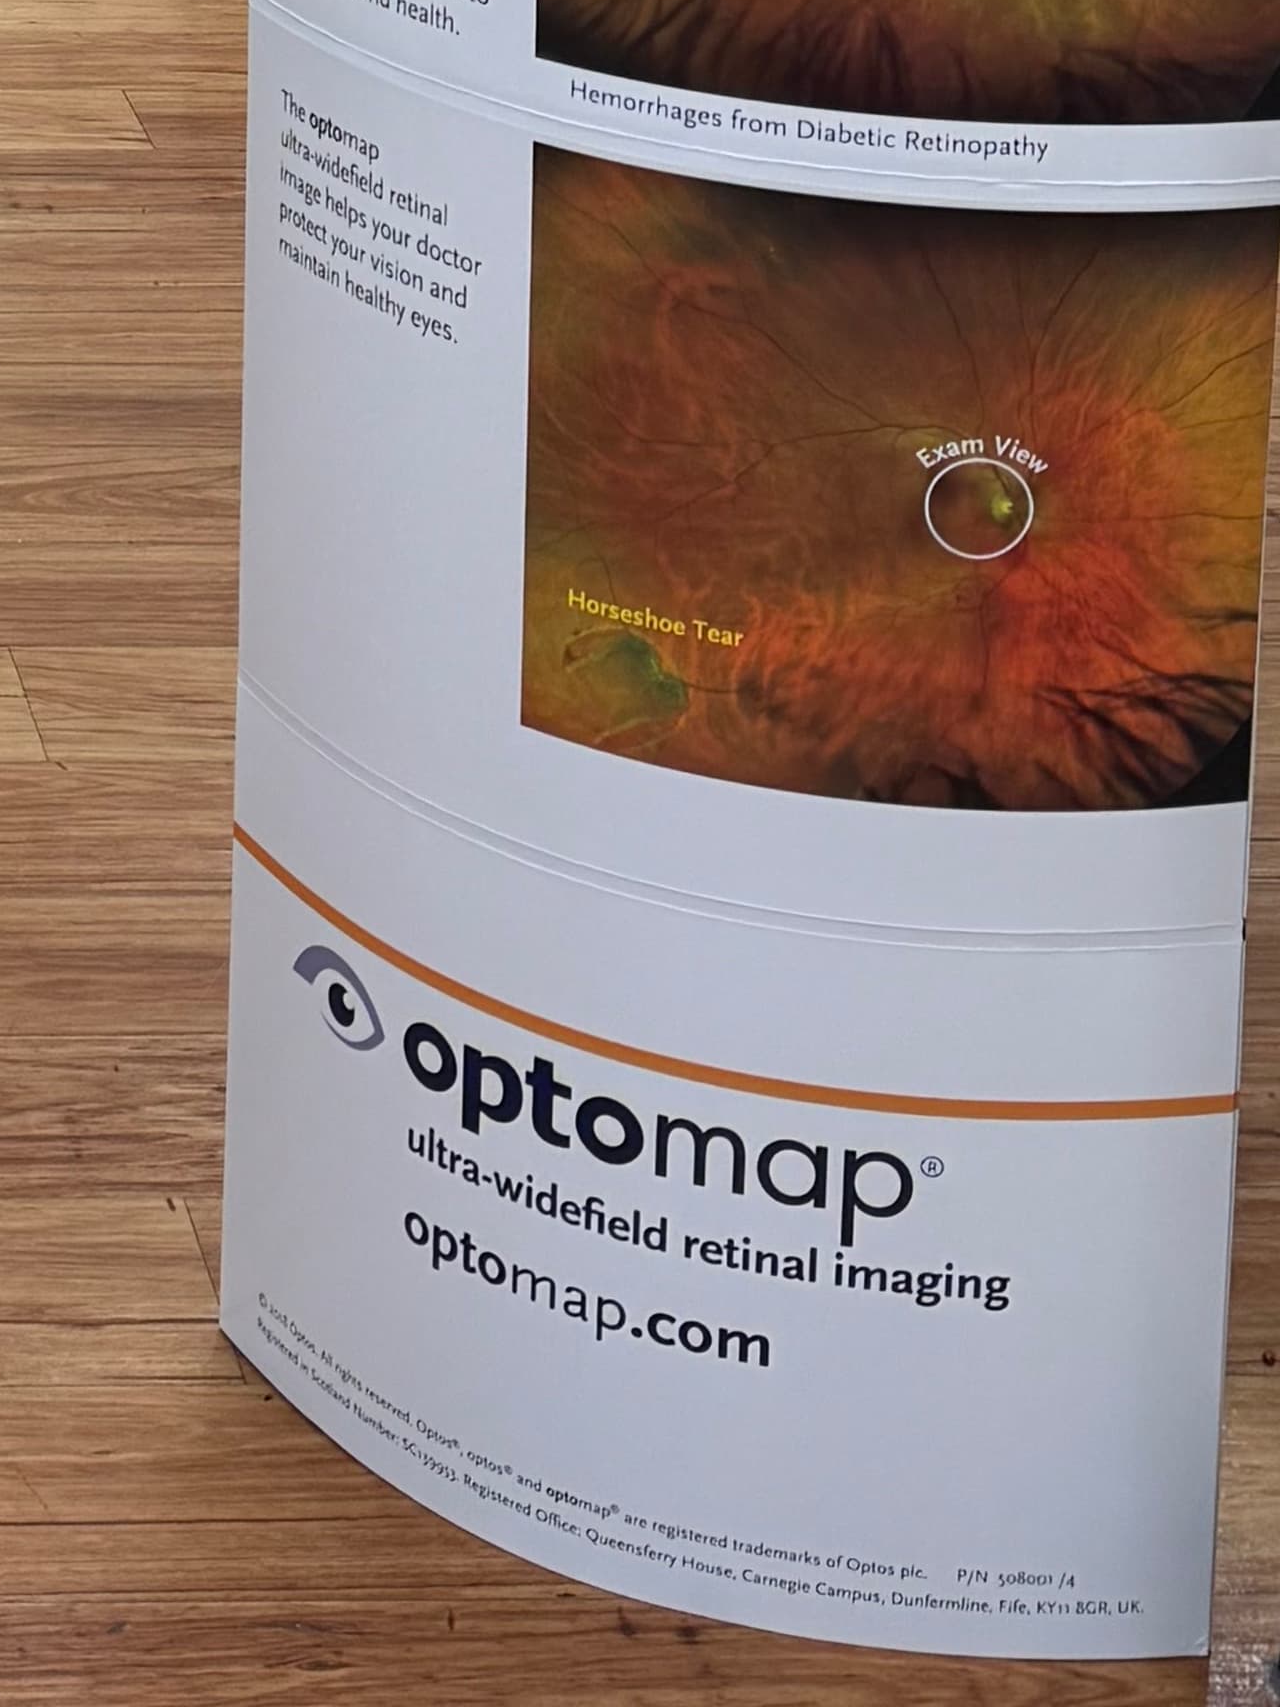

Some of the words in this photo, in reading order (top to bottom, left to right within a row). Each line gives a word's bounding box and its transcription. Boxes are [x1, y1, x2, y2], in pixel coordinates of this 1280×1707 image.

[281, 88, 306, 123] The
[309, 112, 379, 165] optomap
[570, 80, 723, 128] Hemorrhages
[731, 109, 787, 140] from
[797, 120, 896, 151] Diabetic
[905, 131, 1049, 163] Retinopathy
[280, 163, 321, 205] image
[325, 186, 366, 229] helps
[372, 220, 410, 248] your
[416, 236, 482, 275] doctor
[390, 189, 448, 226] retinal
[331, 234, 365, 265] your
[370, 253, 423, 291] vision
[430, 282, 467, 309] and
[346, 271, 406, 326] healthy
[411, 310, 458, 343] eyes.
[916, 435, 985, 471] Exam
[995, 436, 1049, 475] View
[568, 588, 686, 637] Horseshoe
[692, 618, 744, 647] Tear
[403, 1020, 946, 1247] optomap®
[407, 1126, 669, 1254] ultra-widefield
[684, 1228, 818, 1284] retinal
[834, 1253, 1010, 1312] imaging
[404, 1211, 772, 1368] optomap.com
